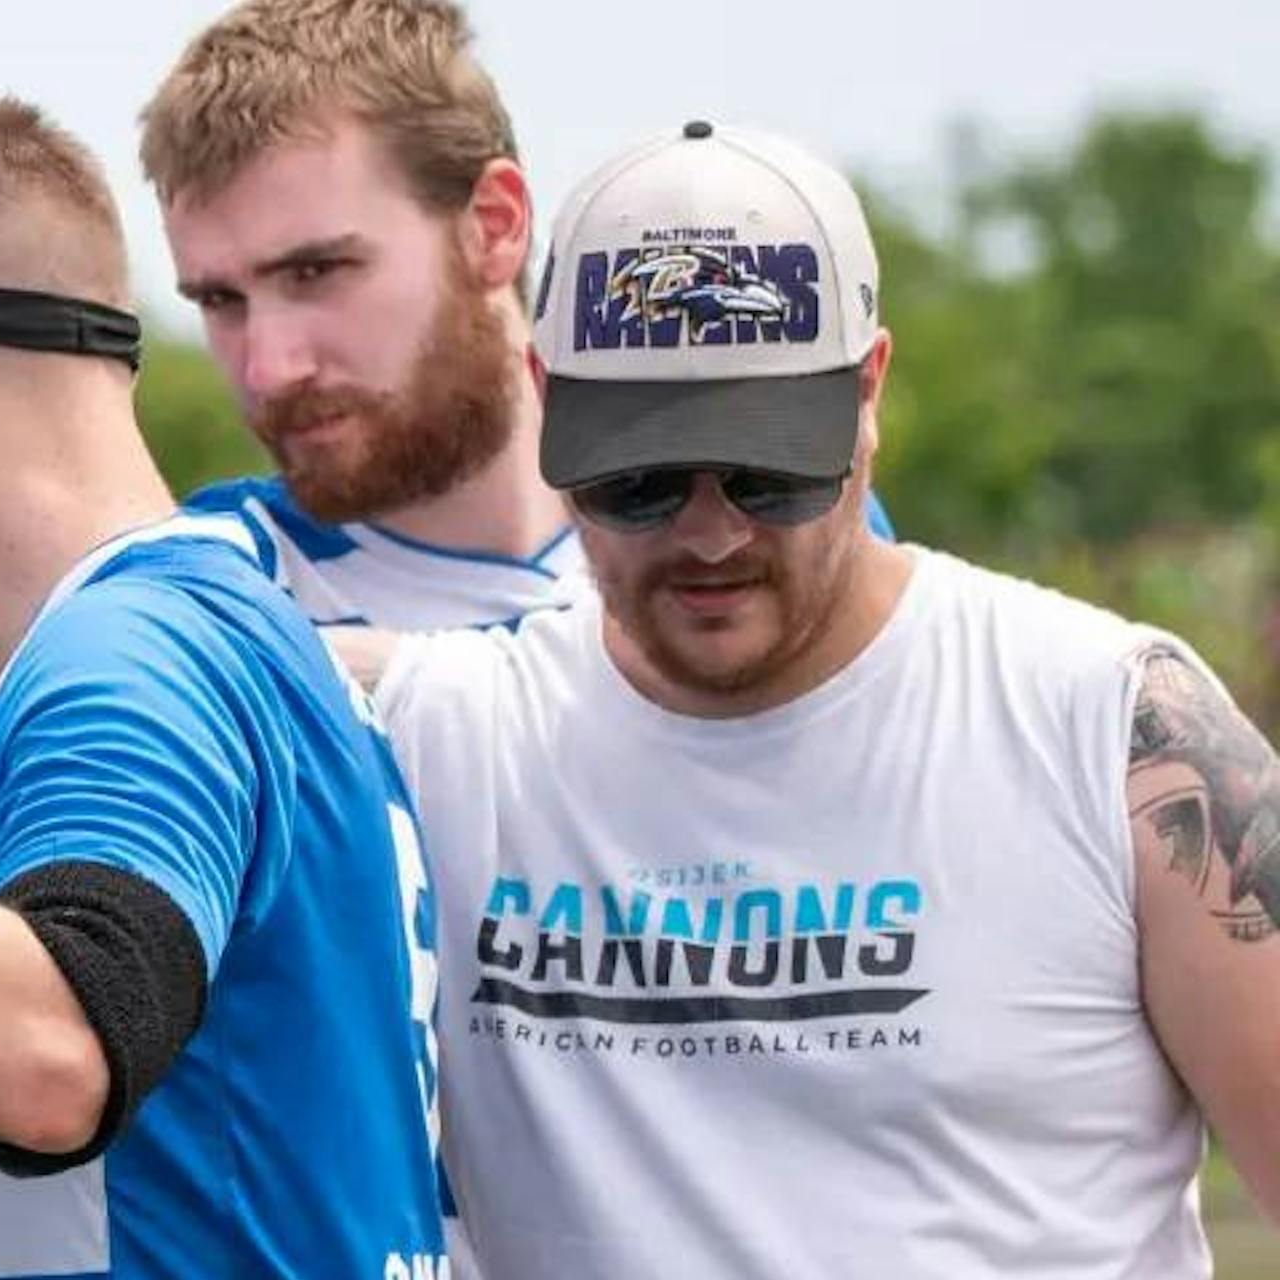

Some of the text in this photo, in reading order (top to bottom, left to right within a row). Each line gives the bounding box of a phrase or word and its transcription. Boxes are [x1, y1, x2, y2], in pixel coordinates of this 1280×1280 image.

[642, 228, 737, 241] BALTIMORE
[476, 876, 923, 989] CANNONS
[631, 1031, 810, 1058] FOOTBALL
[827, 1028, 922, 1048] TEAM
